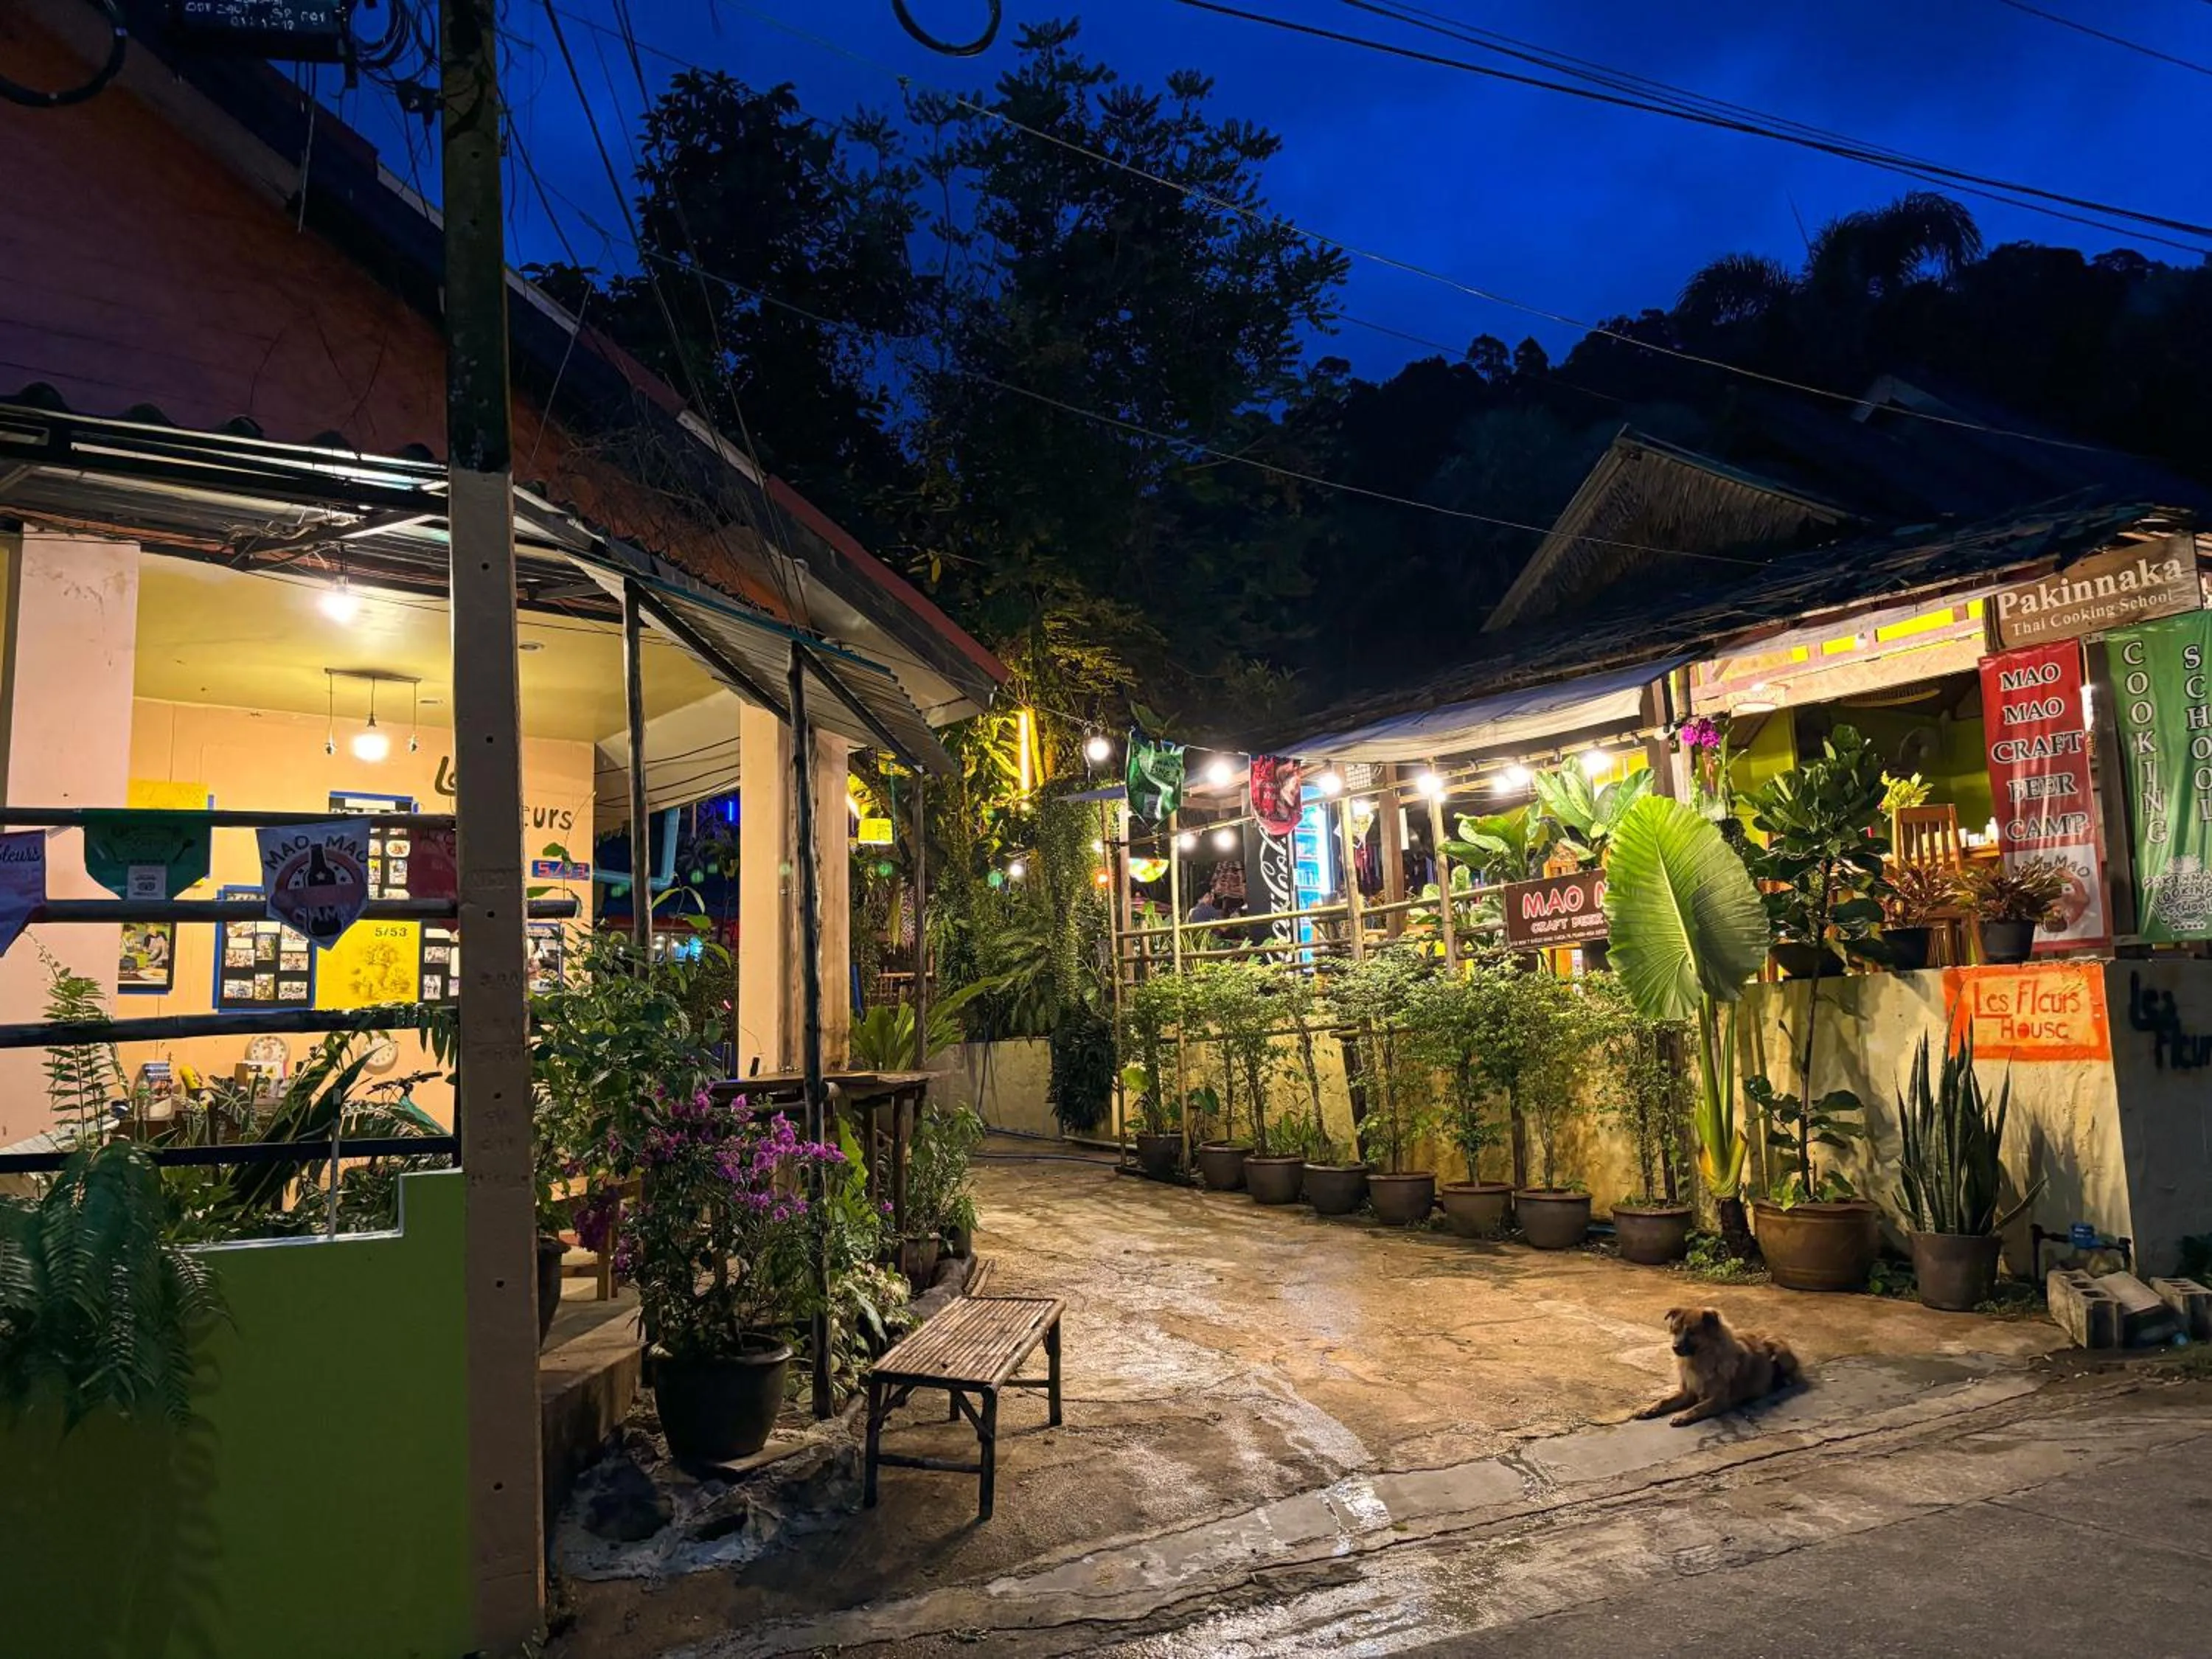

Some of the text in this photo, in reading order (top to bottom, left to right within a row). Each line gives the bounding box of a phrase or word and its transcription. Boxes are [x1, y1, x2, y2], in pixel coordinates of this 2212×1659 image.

[1997, 559, 2183, 619] Pakinnaka
[2013, 591, 2173, 637] Thai Cooking School
[2000, 663, 2061, 692] MAO
[2003, 697, 2065, 726] MAO
[1992, 730, 2084, 764] CRAFT
[2122, 641, 2167, 844] COOKING
[2007, 773, 2079, 802] BEER
[2006, 812, 2088, 841] CAMP
[265, 835, 310, 870] MAO
[1523, 885, 1584, 919] MAO
[375, 925, 408, 937] 5/53
[1531, 918, 1568, 933] CRAFT
[1974, 978, 2081, 1018] Les Fleurs
